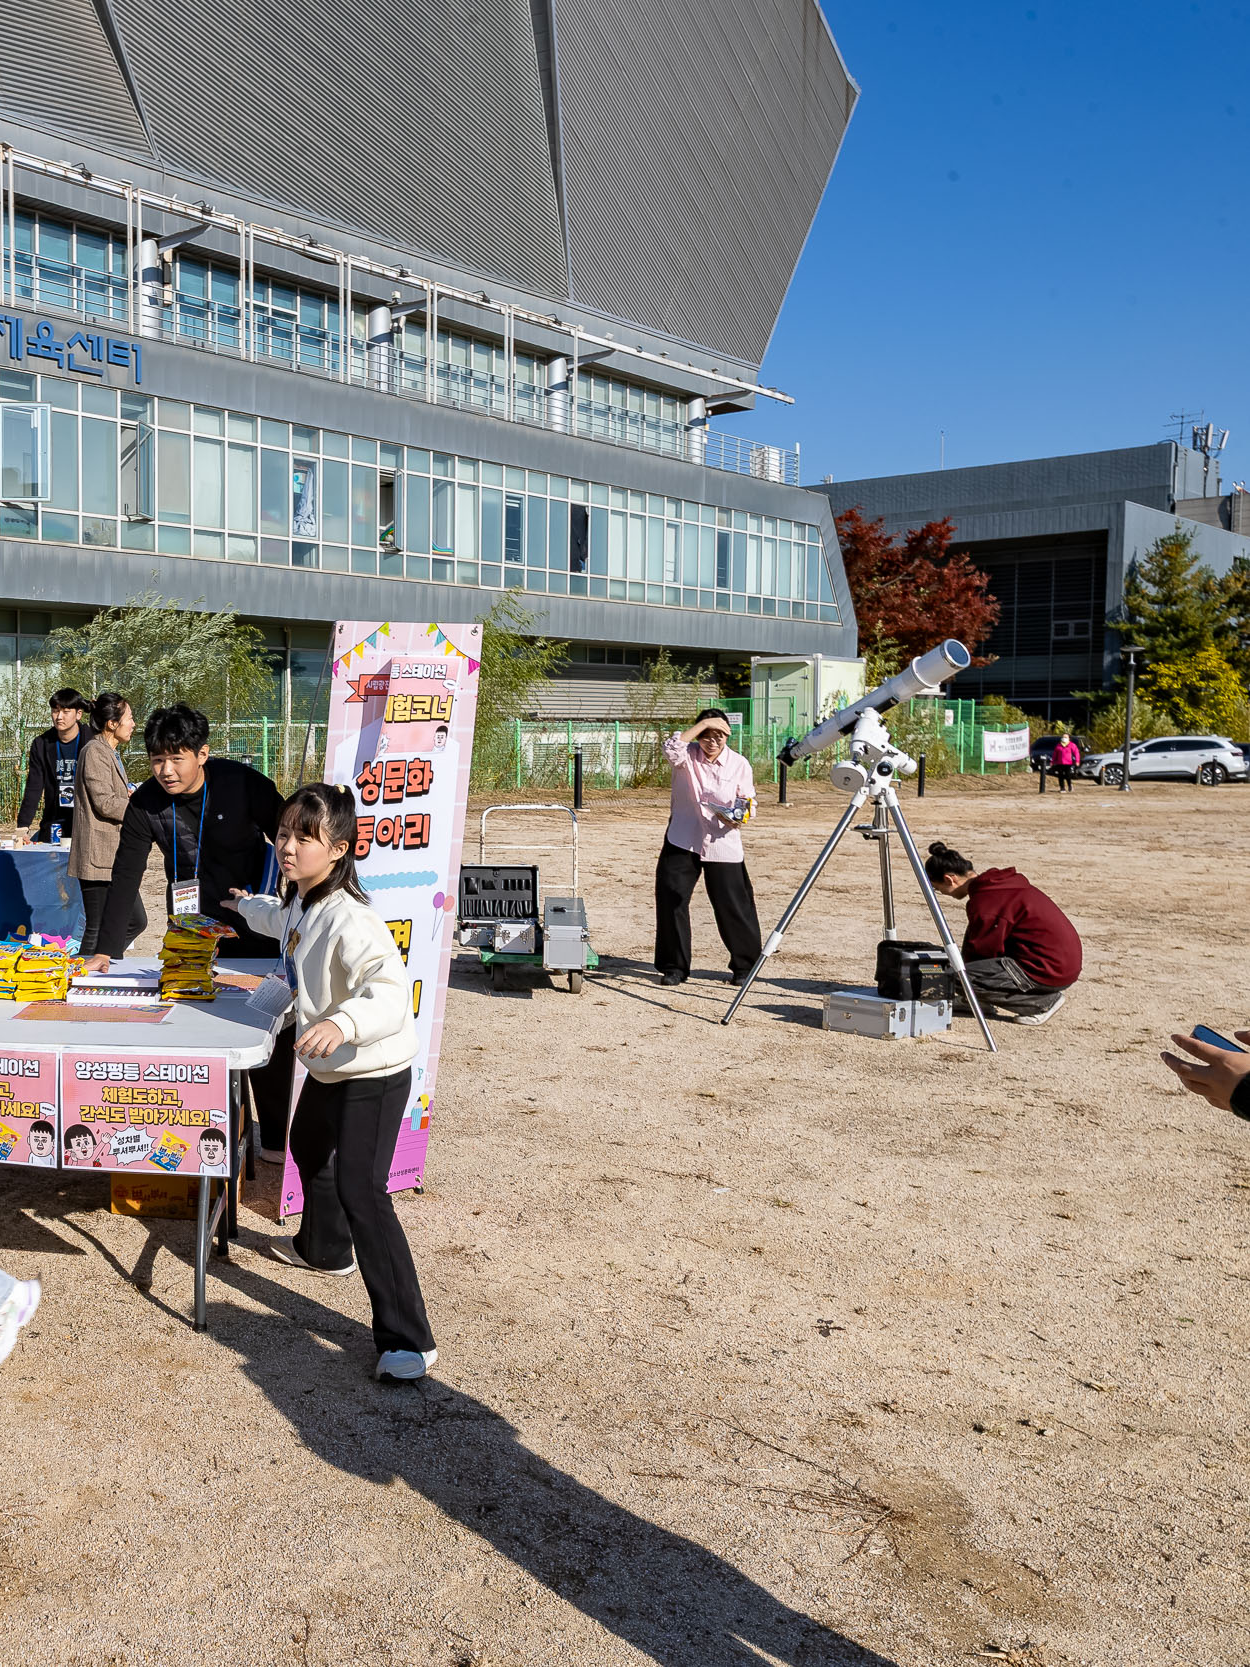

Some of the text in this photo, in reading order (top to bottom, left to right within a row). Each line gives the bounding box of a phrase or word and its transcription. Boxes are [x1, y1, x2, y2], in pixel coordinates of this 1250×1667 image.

[401, 663, 448, 679] 스테이션
[356, 758, 433, 806] 성문화
[353, 813, 431, 861] 동아리
[75, 1061, 210, 1084] 양성평등 스테이션
[102, 1086, 183, 1107] 체험도하고,
[79, 1105, 211, 1127] 간식도 받아가세요!
